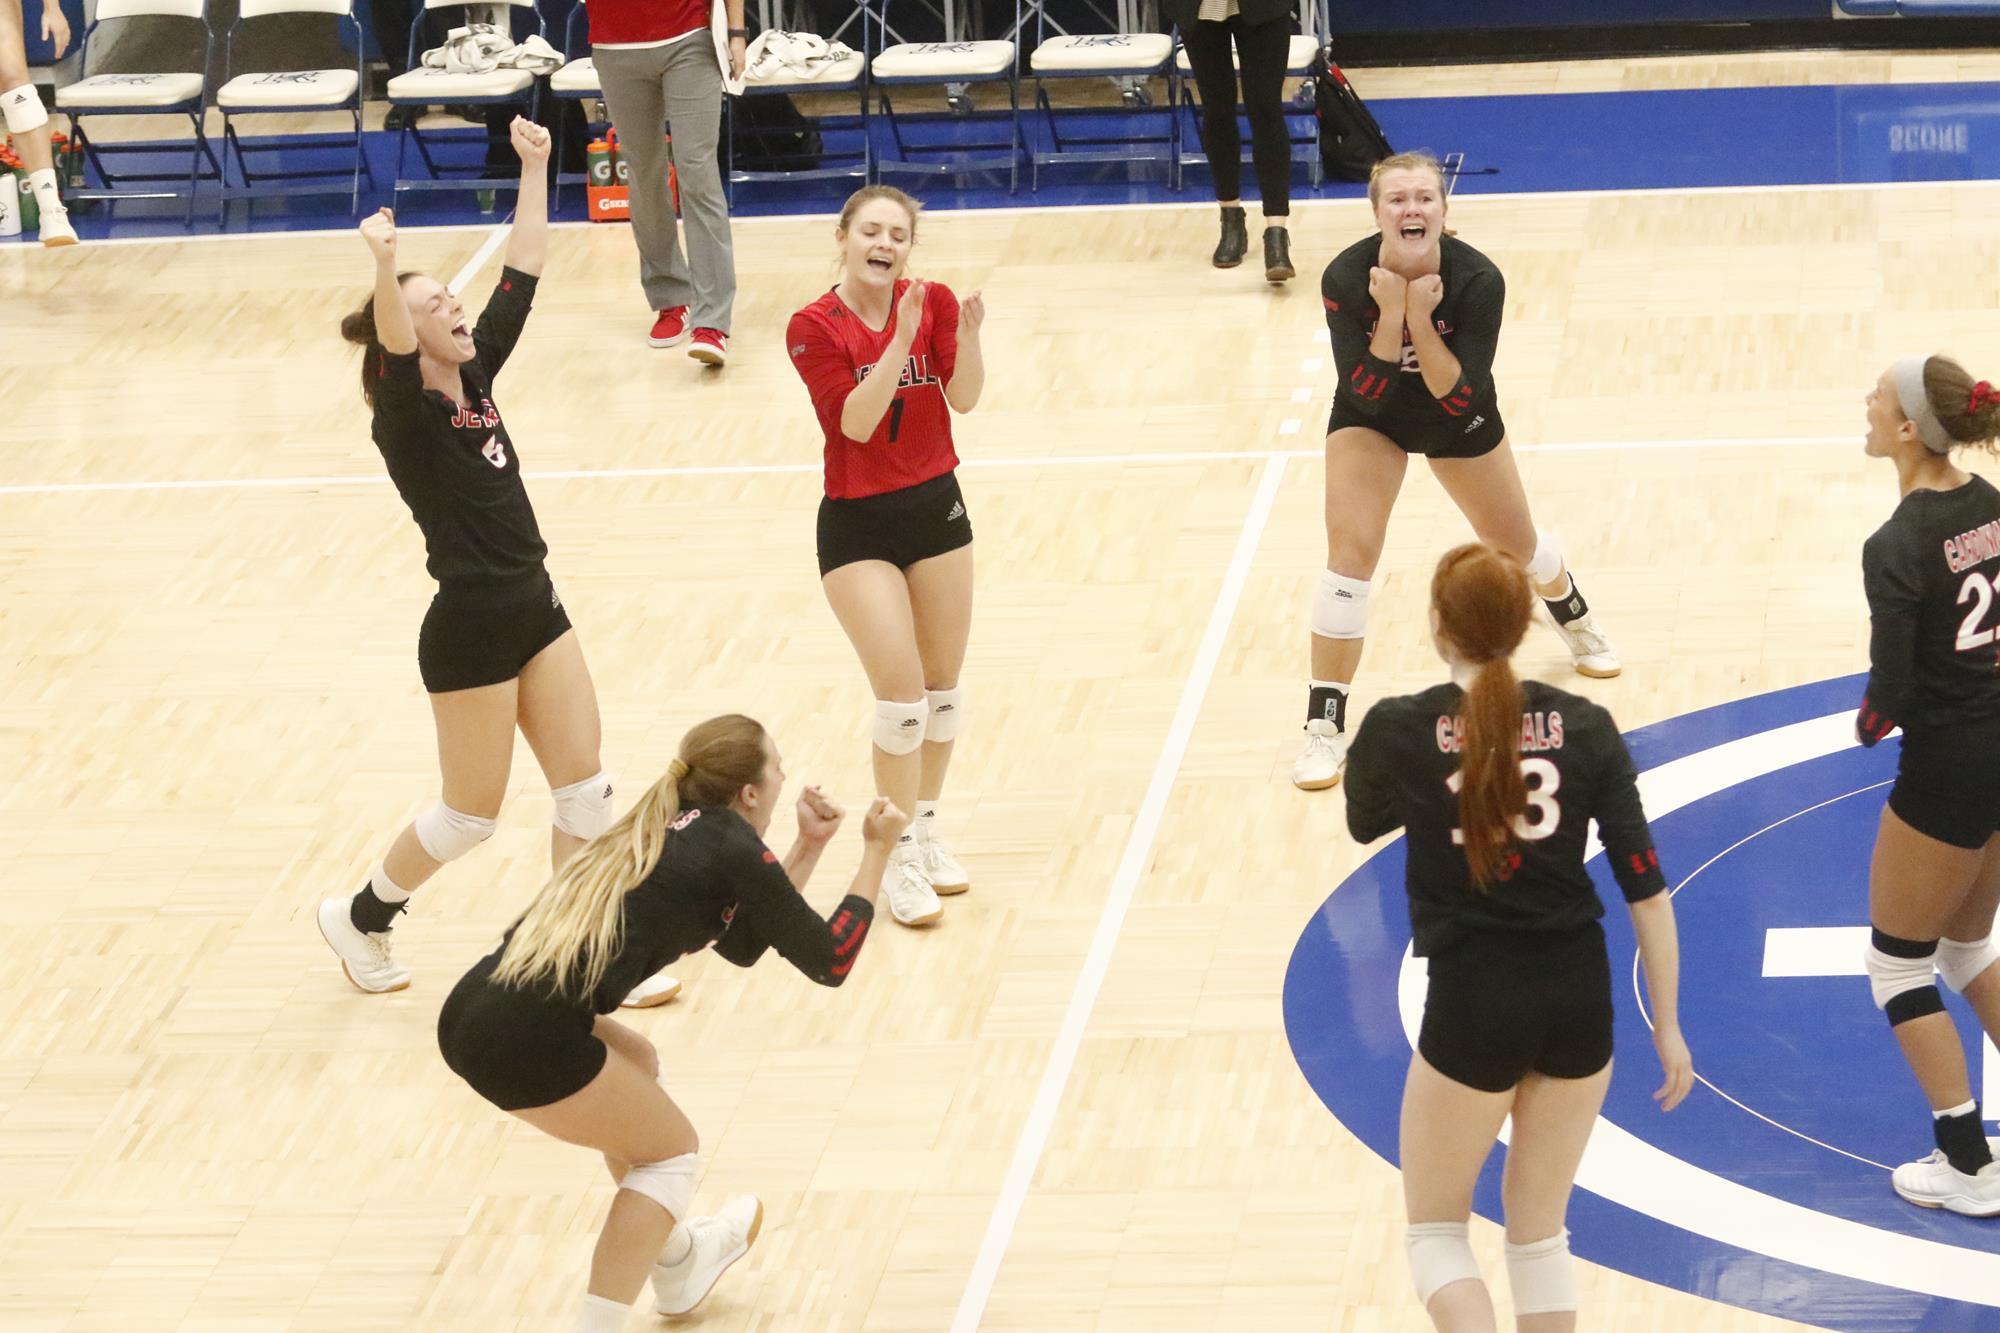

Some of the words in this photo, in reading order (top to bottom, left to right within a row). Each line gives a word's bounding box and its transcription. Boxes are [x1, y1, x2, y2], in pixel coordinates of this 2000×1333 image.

[594, 160, 611, 179] G
[616, 161, 628, 179] G
[481, 433, 507, 469] 6
[1435, 710, 1565, 754] CAALS
